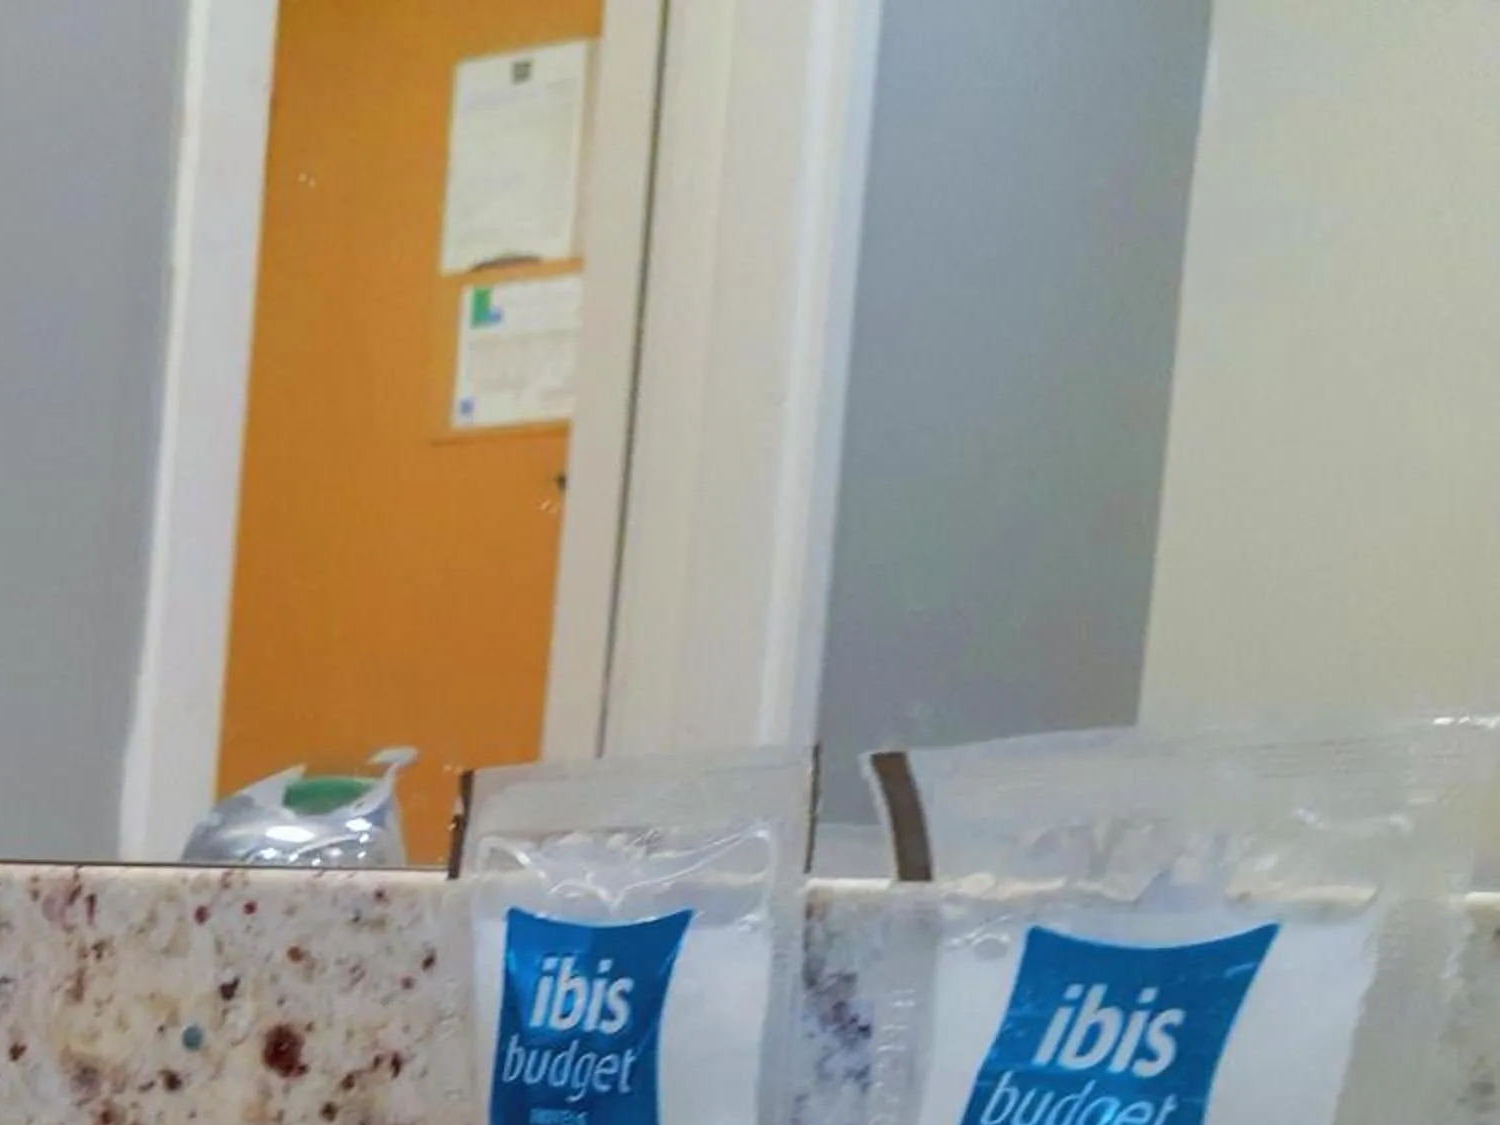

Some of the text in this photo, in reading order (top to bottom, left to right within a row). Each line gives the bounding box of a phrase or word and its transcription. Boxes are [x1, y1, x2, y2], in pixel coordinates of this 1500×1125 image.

[528, 956, 634, 1035] ibis
[1031, 983, 1186, 1078] ibis
[502, 1033, 637, 1103] budget
